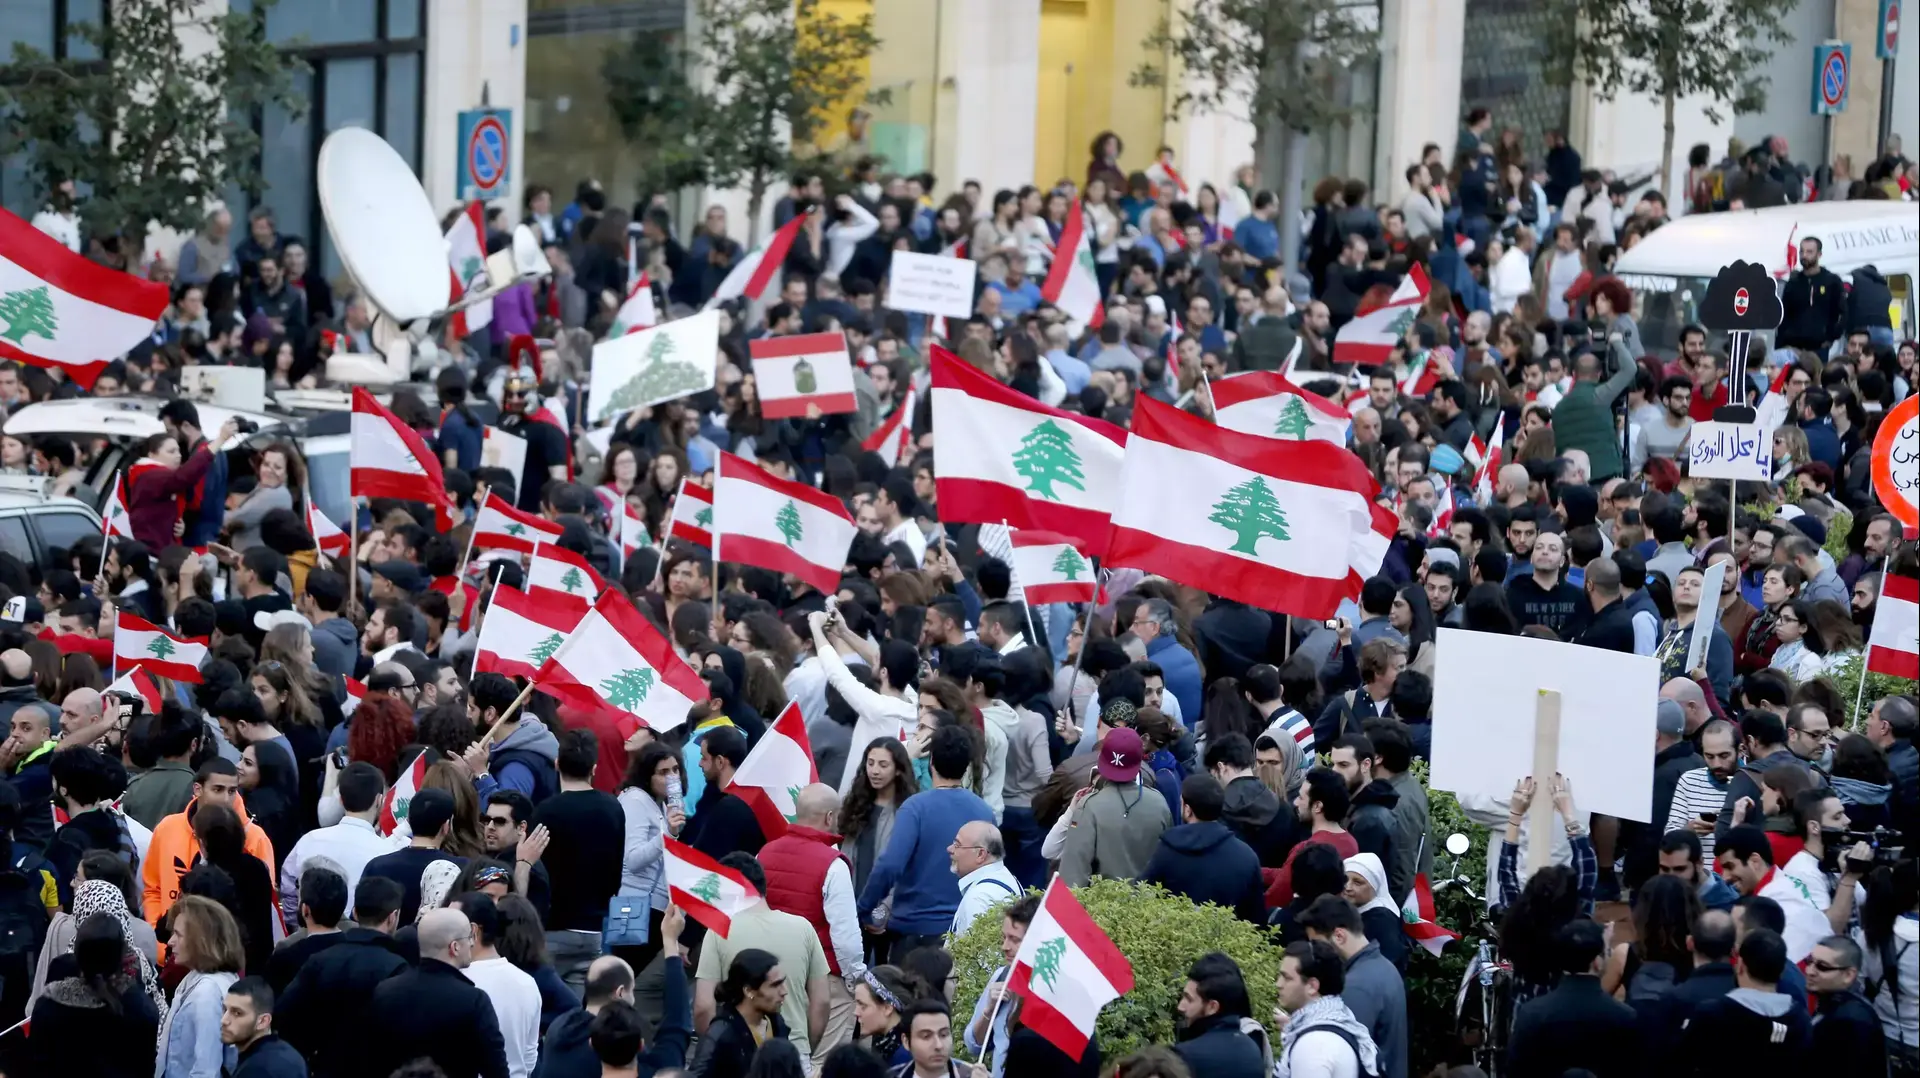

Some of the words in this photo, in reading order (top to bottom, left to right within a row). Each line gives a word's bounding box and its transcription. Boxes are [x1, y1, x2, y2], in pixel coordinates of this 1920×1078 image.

[1828, 226, 1898, 250] TITANIC
[1756, 429, 1769, 477] يا
[1525, 602, 1548, 613] NEW
